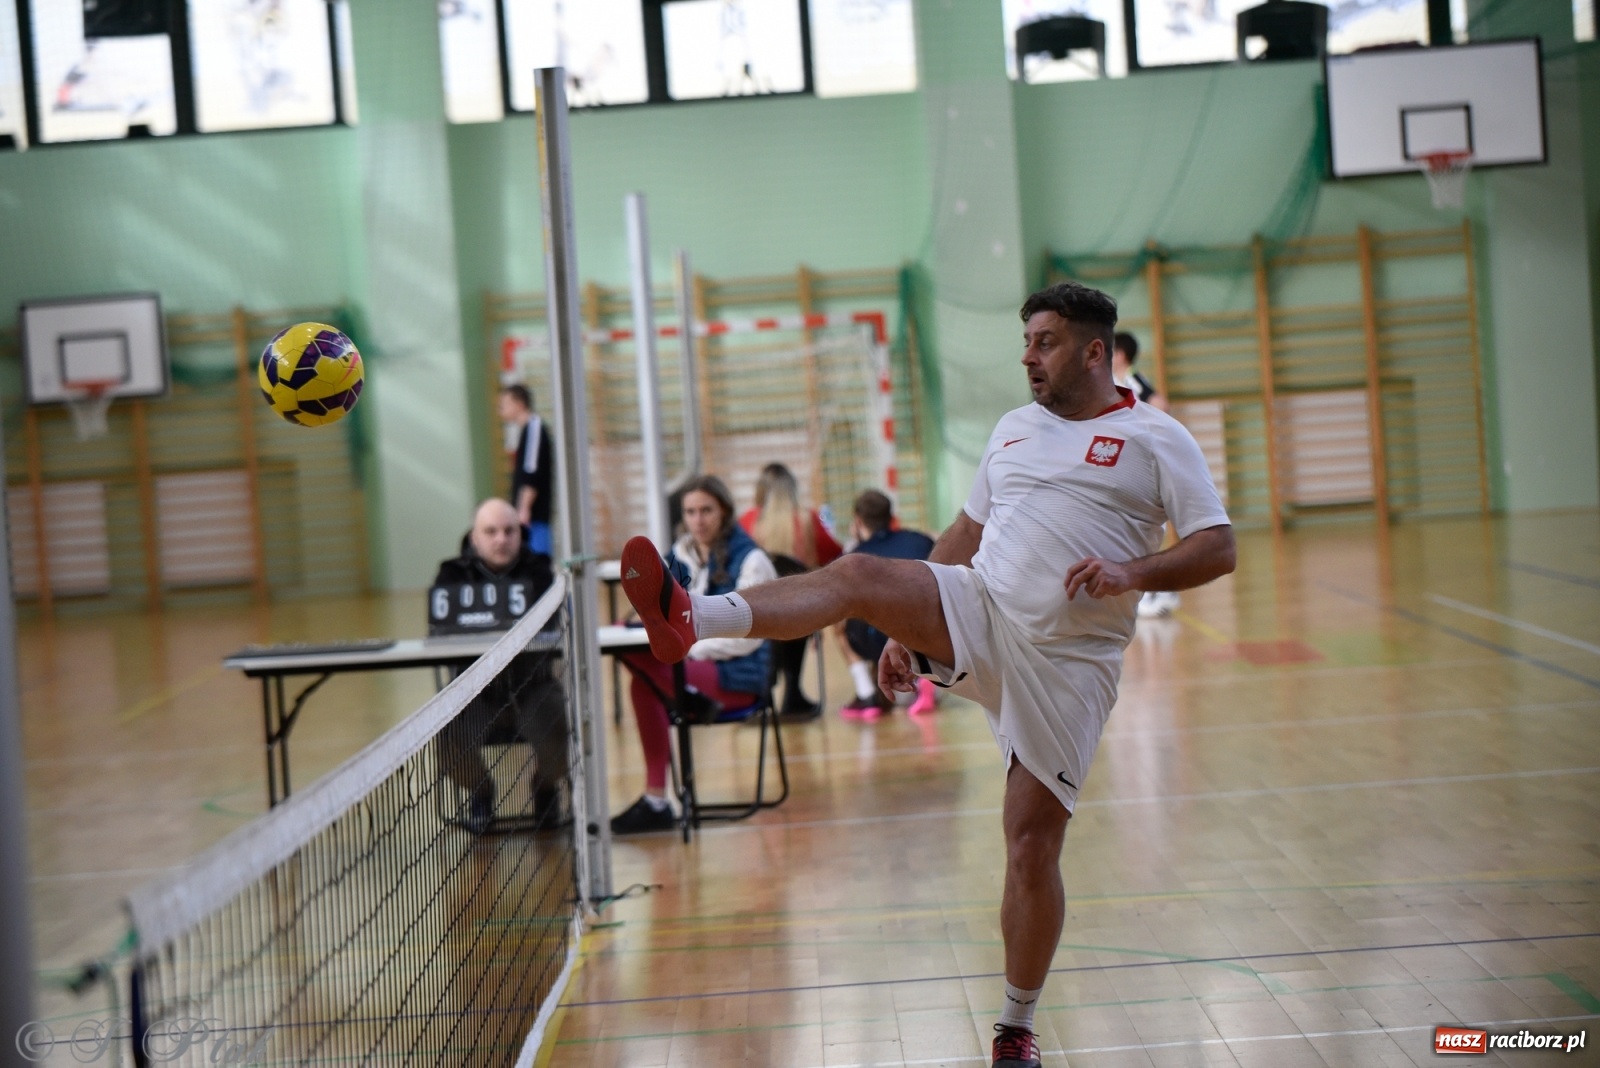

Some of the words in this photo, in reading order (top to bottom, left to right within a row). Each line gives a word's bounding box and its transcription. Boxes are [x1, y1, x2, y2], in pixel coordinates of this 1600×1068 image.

[431, 588, 449, 620] 6
[459, 584, 474, 608] 0
[482, 583, 497, 606] 0
[508, 583, 526, 615] 5
